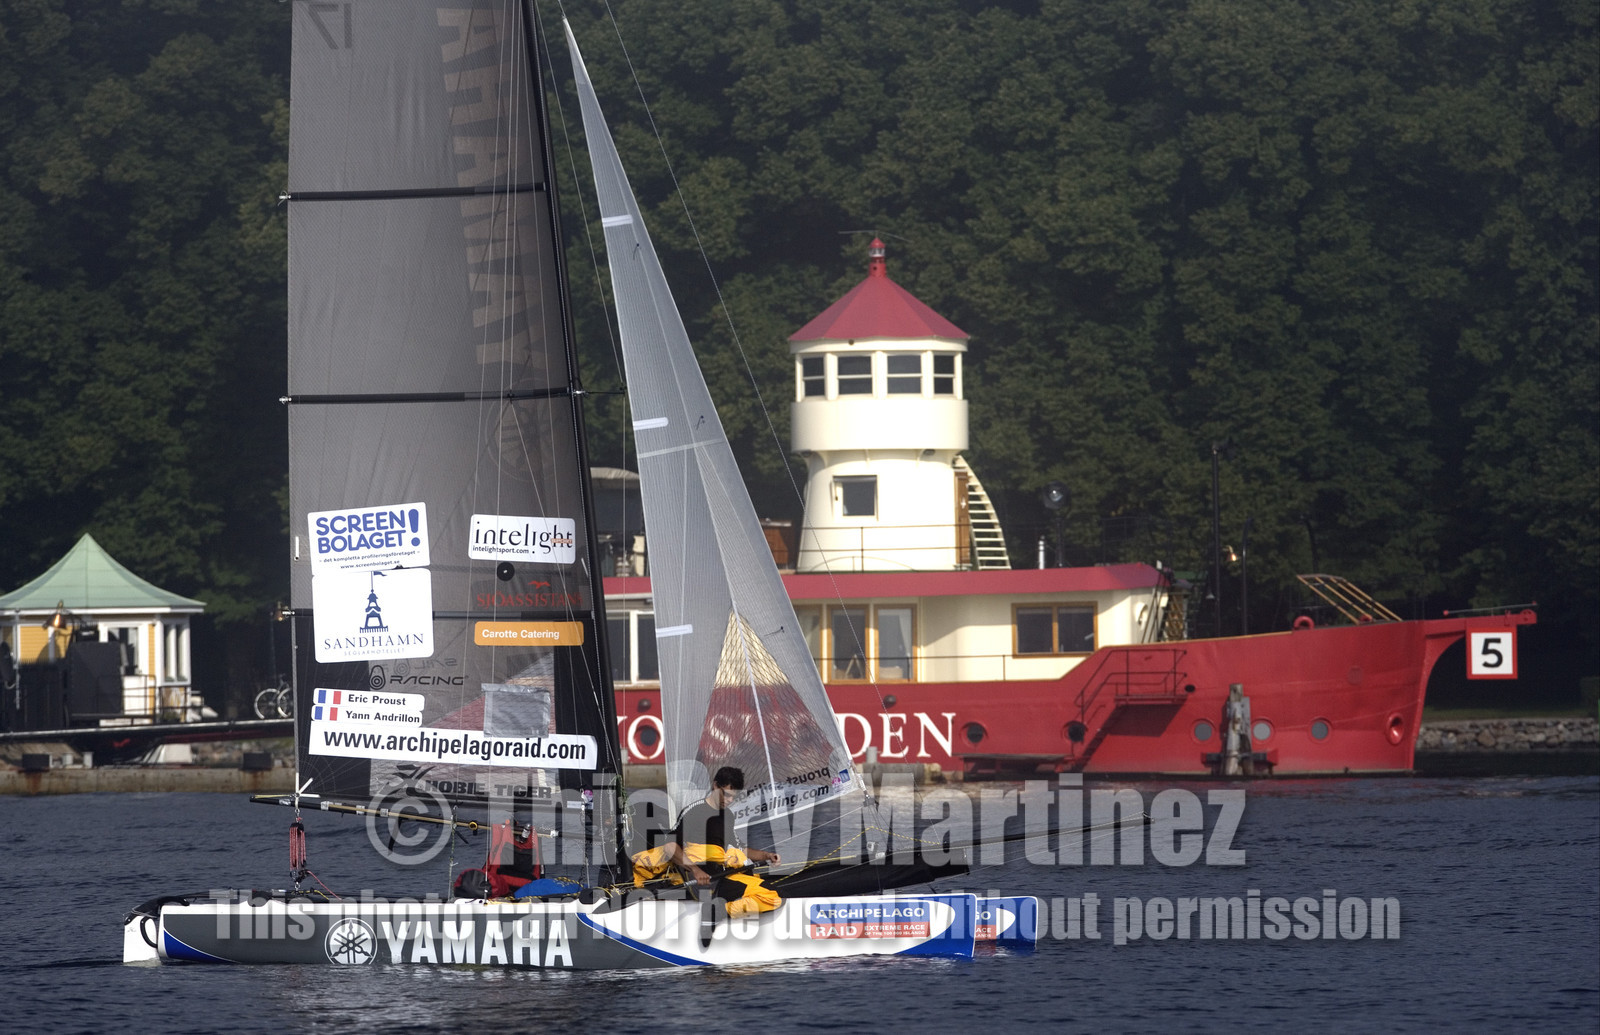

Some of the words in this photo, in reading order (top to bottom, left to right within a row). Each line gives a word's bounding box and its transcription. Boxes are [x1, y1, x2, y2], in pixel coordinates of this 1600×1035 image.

[316, 510, 405, 536] SCREEN
[317, 530, 406, 553] BOLAGET
[472, 545, 530, 554] intelightsport.com
[334, 555, 361, 563] kompletta
[482, 629, 518, 638] Carotte
[520, 629, 560, 640] Catering
[324, 633, 424, 650] SANDHAMN
[1481, 637, 1503, 668] 5
[389, 674, 464, 686] RACING
[348, 694, 368, 703] Eric
[372, 695, 406, 705] Proust
[346, 710, 370, 720] Yann
[374, 712, 420, 723] Andrillon
[323, 731, 586, 761] www.archipelagoraid.com
[425, 780, 485, 795] HOBIE
[494, 785, 551, 798] TIGER
[816, 907, 925, 919] ARCHIPELAGO
[815, 925, 857, 937] RAID
[381, 919, 574, 966] YAMAHA
